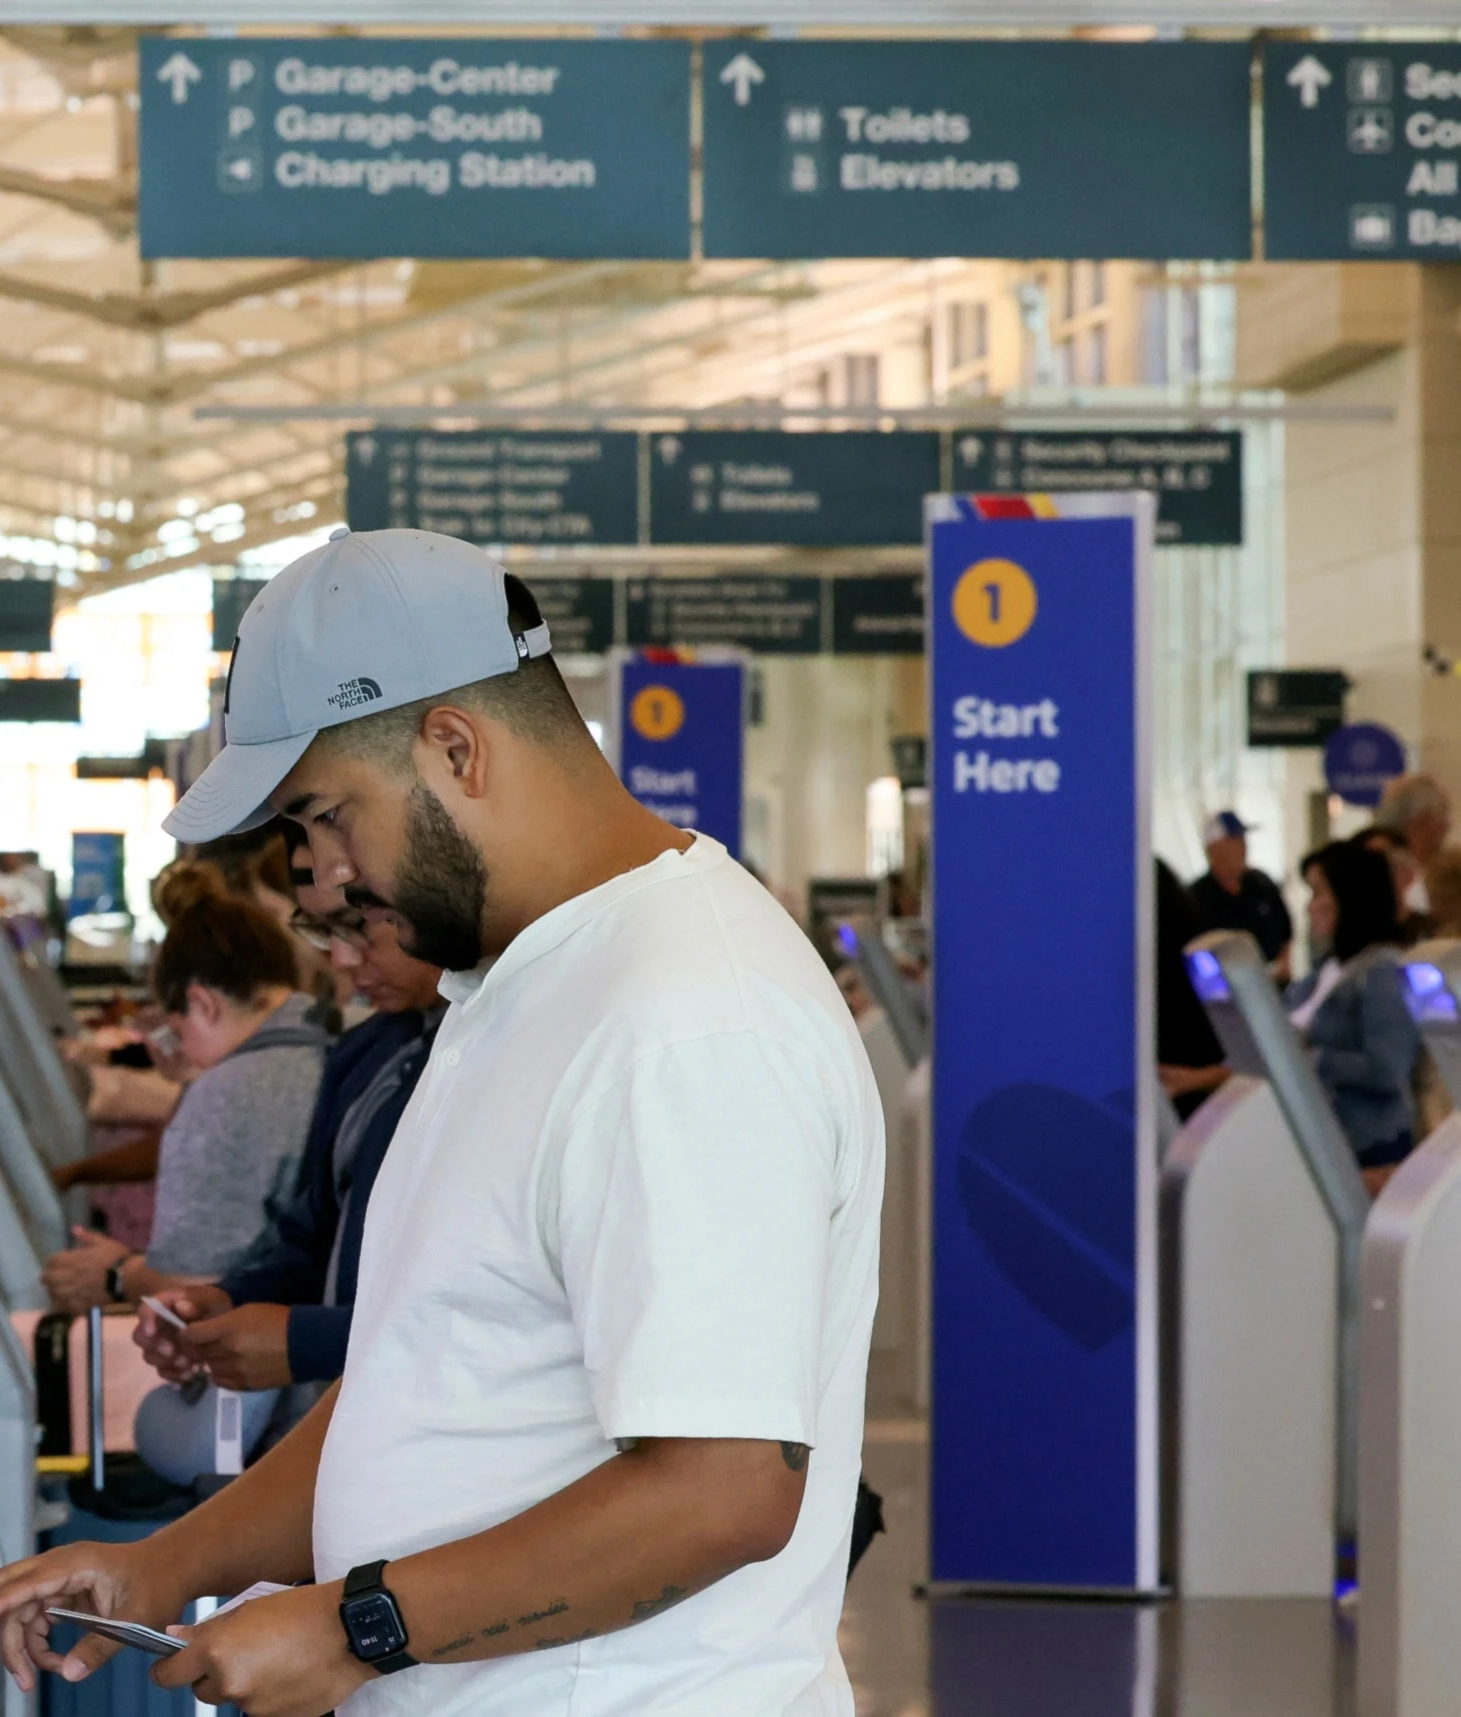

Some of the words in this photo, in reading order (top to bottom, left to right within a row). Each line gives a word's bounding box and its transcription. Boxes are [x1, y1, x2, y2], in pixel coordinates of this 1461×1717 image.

[275, 58, 559, 101] Garage-Center
[275, 105, 543, 148] Garage-South
[840, 107, 970, 143] Toilets
[274, 152, 451, 195] Charging
[459, 152, 596, 188] Station
[840, 153, 1020, 190] Elevators
[983, 583, 1001, 623] 1
[327, 687, 361, 706] NORTH
[338, 679, 358, 692] THE
[339, 695, 364, 710] FACE
[953, 696, 1058, 739] Start
[631, 766, 696, 795] Start
[954, 751, 1060, 793] Here
